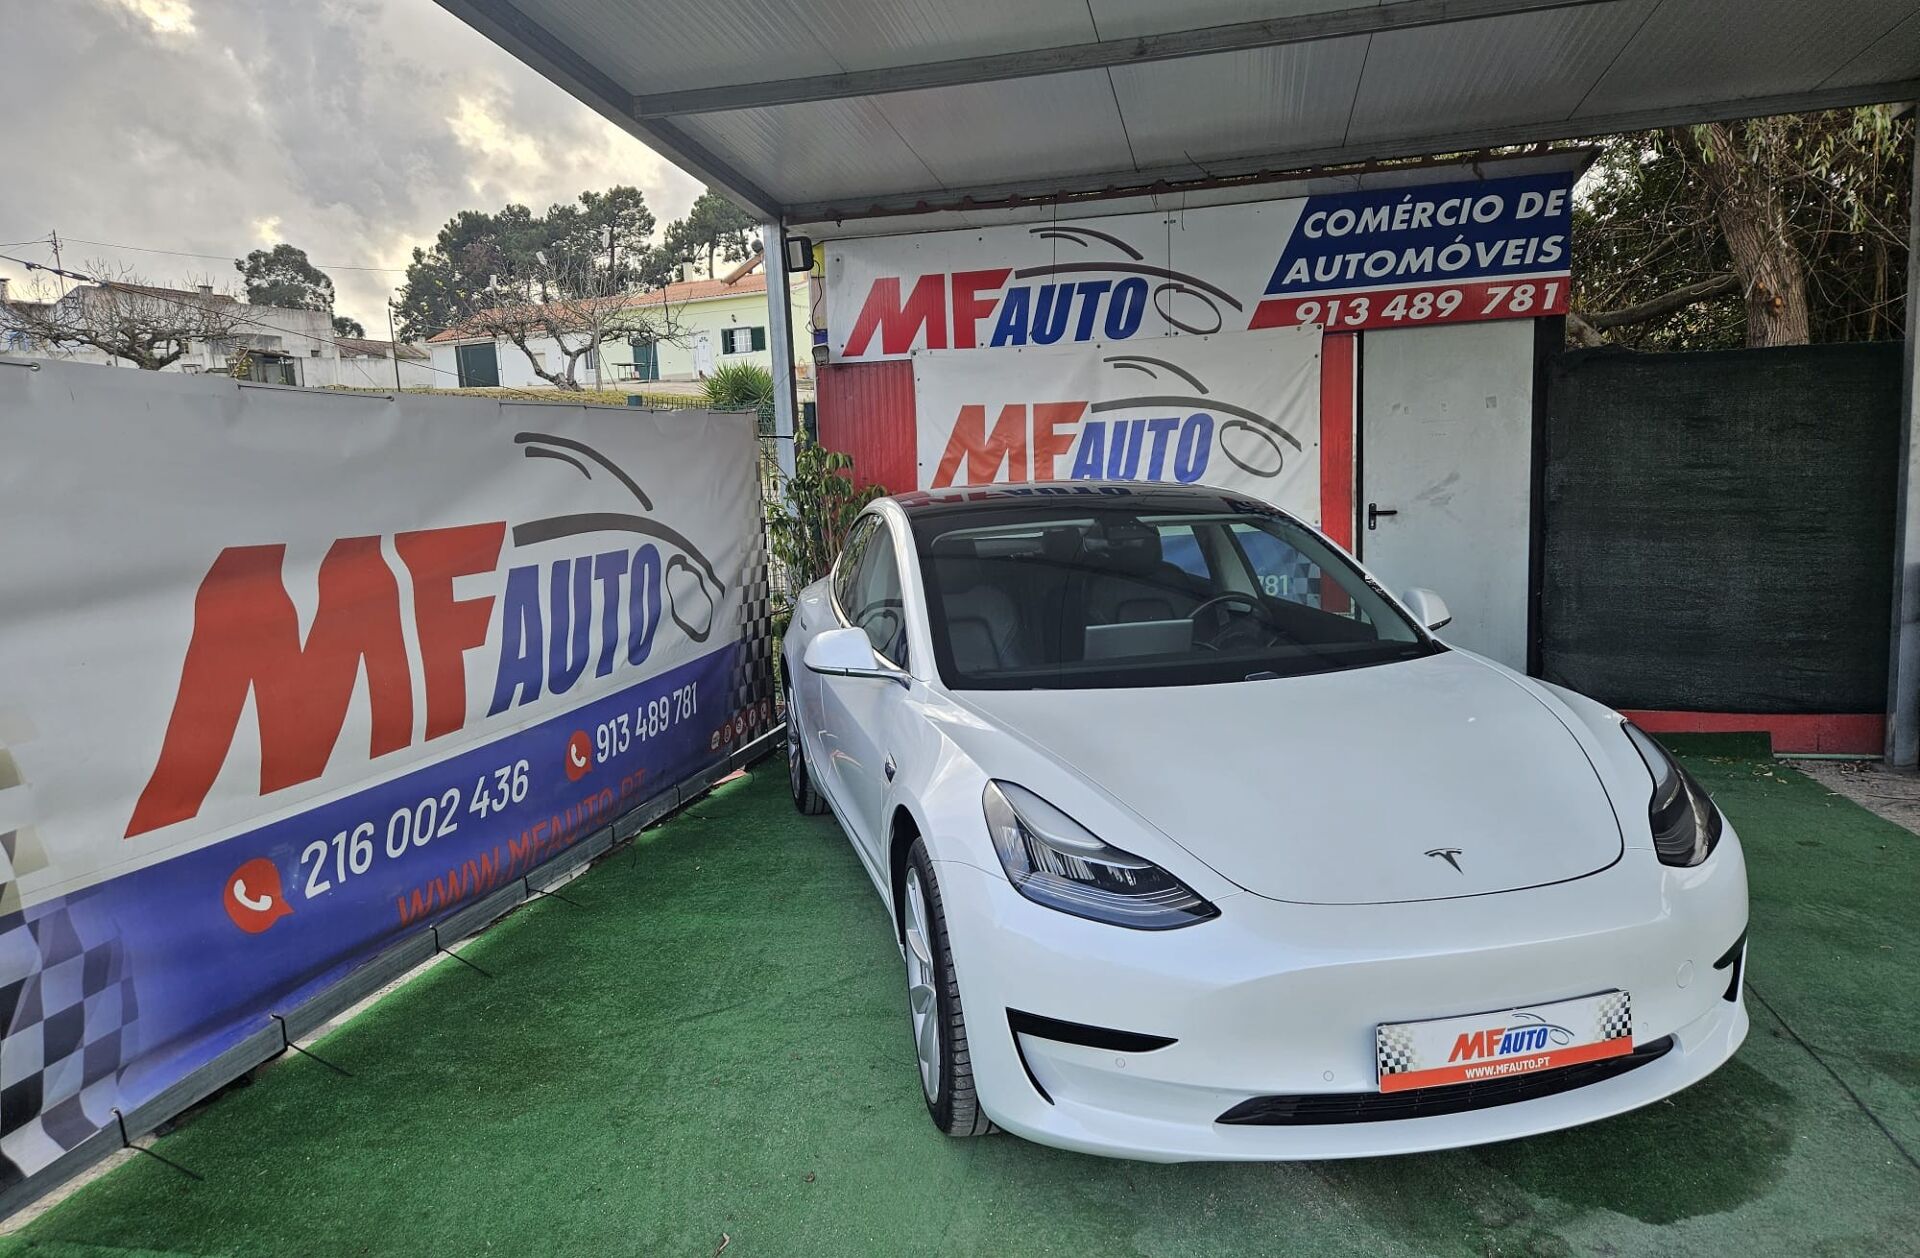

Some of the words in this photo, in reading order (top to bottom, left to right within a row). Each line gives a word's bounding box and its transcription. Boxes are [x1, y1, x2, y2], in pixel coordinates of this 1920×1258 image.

[1303, 194, 1504, 239] COMÉRCIO
[1515, 188, 1566, 220] DE
[1282, 233, 1565, 285] AUTOMÓVEIS
[1294, 297, 1371, 328] 913
[1381, 289, 1465, 322] 489
[1482, 283, 1560, 316] 781
[595, 718, 631, 764] 913
[635, 696, 670, 741] 489
[672, 680, 698, 724] 781
[300, 821, 375, 899] 216
[385, 787, 460, 859] 002
[468, 759, 529, 819] 436
[1464, 1056, 1551, 1080] WWW.MFAUTO.PT
